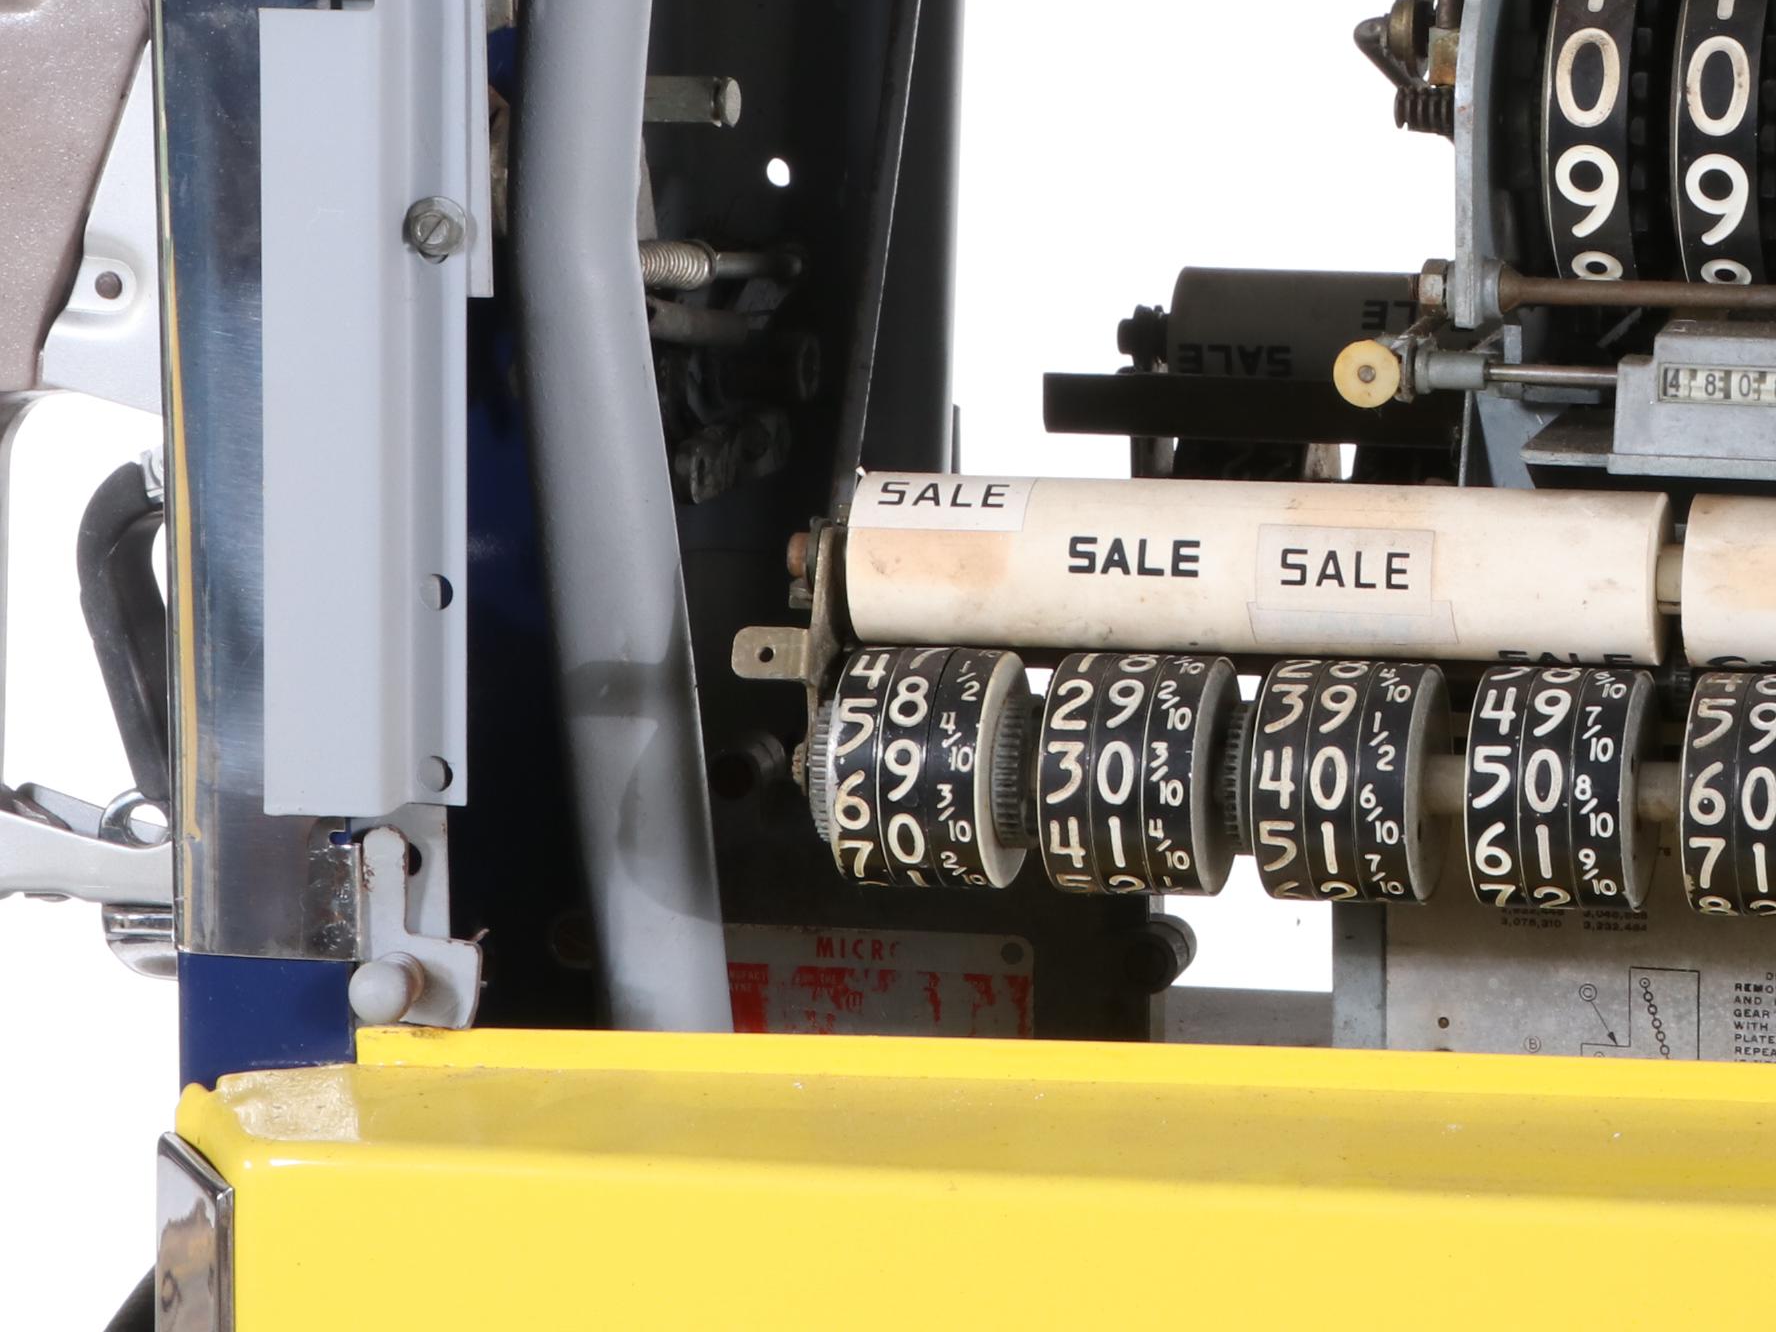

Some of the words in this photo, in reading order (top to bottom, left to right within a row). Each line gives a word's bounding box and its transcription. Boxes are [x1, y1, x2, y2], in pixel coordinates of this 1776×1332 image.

[878, 481, 1011, 508] SALE
[1068, 536, 1201, 577] SALE
[1279, 547, 1411, 590] SALE
[1734, 997, 1762, 1005] AND
[1734, 1010, 1770, 1019] GEAR
[1734, 1022, 1769, 1032] WITH
[1734, 1034, 1776, 1044] PLATE
